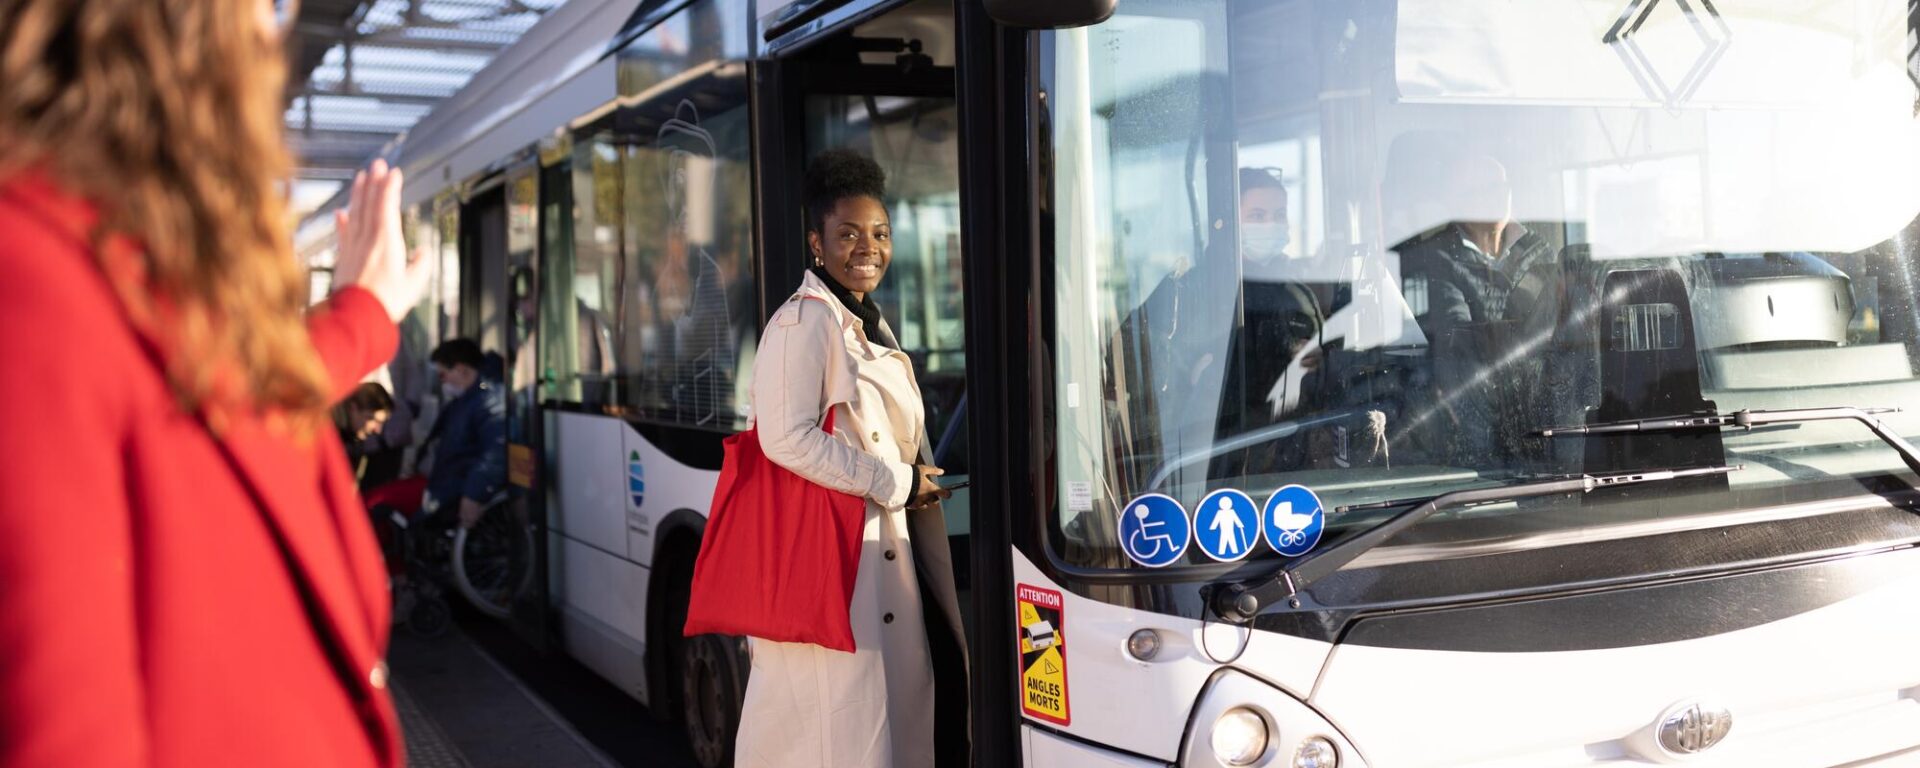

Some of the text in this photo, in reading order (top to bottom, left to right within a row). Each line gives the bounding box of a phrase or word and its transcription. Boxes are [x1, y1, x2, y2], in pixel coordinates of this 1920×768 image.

[1020, 588, 1060, 606] ATTENTION
[1027, 677, 1060, 696] ANGLES
[1029, 692, 1060, 711] MORTS
